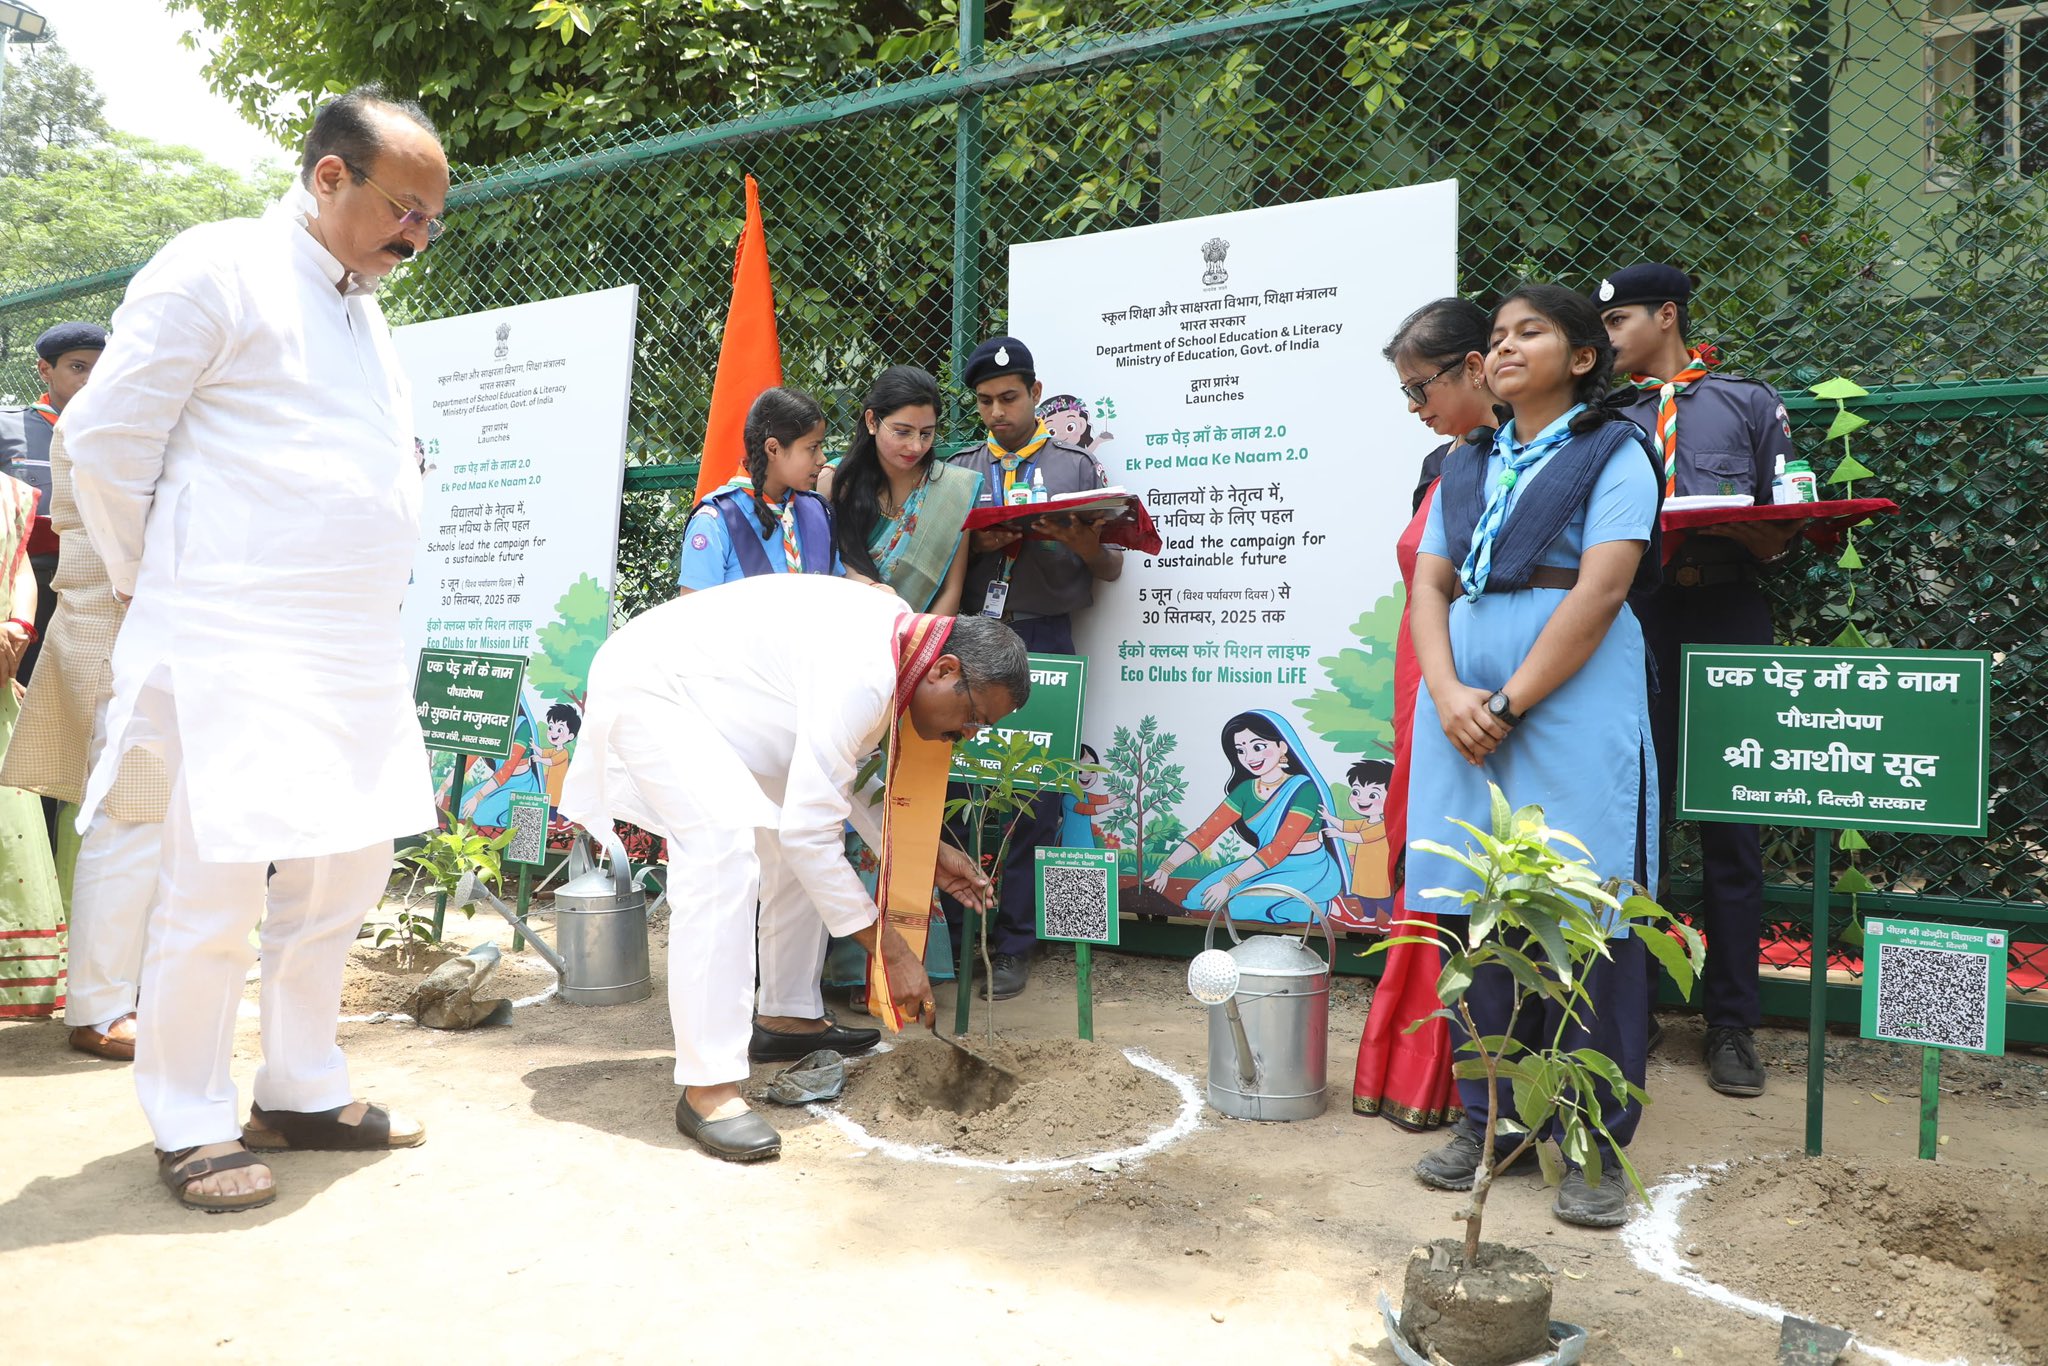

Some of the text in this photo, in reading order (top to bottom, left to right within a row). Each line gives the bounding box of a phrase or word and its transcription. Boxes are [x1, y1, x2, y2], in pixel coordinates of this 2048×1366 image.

[1101, 287, 1338, 325] स्कूल शिक्षा और साक्षरता विभाग, शिक्षा मंत्रालय
[1180, 315, 1246, 331] भारत सरकार
[1097, 323, 1343, 358] Department of School Education & Literacy
[1116, 338, 1319, 367] Ministry of Education, Govt. of India
[1191, 374, 1239, 392] द्वारा प्रारंभ
[433, 397, 469, 409] Department
[470, 395, 477, 403] of
[477, 392, 499, 402] School
[500, 389, 532, 399] Education
[540, 385, 566, 394] Literacy
[443, 396, 553, 416] Ministry of Education, Govt. of India
[1186, 391, 1244, 404] Launches
[478, 434, 510, 444] Launches
[1145, 433, 1169, 446] एक
[1193, 425, 1211, 442] माँ
[1213, 426, 1228, 441] के
[1231, 426, 1261, 440] नाम
[1265, 425, 1286, 438] 2.0
[454, 465, 467, 474] एक
[491, 459, 499, 470] के
[501, 460, 517, 469] नाम
[518, 459, 530, 468] 2.0
[1126, 448, 1308, 470] Ek Ped Maa Ke Naam 2.0
[442, 475, 541, 492] Ek Ped Maa Ke Naam 2.0
[1147, 482, 1283, 507] विद्यालयों के नेतृत्व में,
[451, 501, 525, 518] विद्यालयों के नेतृत्व में,
[1164, 509, 1205, 527] भविष्य
[1209, 508, 1224, 525] के
[1228, 506, 1256, 526] लिए
[1260, 509, 1294, 525] पहल
[459, 520, 482, 533] भविष्य
[484, 520, 492, 532] के
[494, 518, 510, 532] लिए
[512, 520, 530, 532] पहल
[427, 536, 546, 552] Schools lead the campaign for
[1167, 531, 1326, 551] lead the campaign for
[453, 552, 495, 564] sustainable
[499, 551, 524, 561] future
[1144, 551, 1286, 568] a sustainable future
[442, 596, 451, 605] 30
[485, 594, 504, 604] 2025
[507, 594, 520, 604] तक
[1139, 589, 1146, 601] 5
[1151, 589, 1173, 606] जून
[1278, 582, 1291, 599] से
[1143, 606, 1286, 626] 30 सितम्बर, 2025 तक
[427, 636, 529, 649] Eco Clubs for Mission LiFE
[1118, 640, 1311, 661] ईको क्लब्स फॉर मिशन लाइफ
[427, 661, 444, 672] एक
[463, 660, 478, 675] माँ
[478, 661, 490, 676] के
[491, 666, 514, 679] नाम
[1029, 669, 1068, 686] नाम
[1121, 666, 1306, 684] Eco Clubs for Mission LiFE
[1706, 667, 1756, 687] एक
[1813, 662, 1854, 689] माँ
[1857, 663, 1891, 690] के
[1897, 672, 1960, 692] नाम
[447, 684, 484, 699] पौधारोपण
[431, 705, 462, 724] सुकांत
[463, 711, 510, 730] मजुमदार
[1776, 706, 1884, 730] पौधारोपण
[1723, 738, 1940, 787] श्री आशीष सूद
[1732, 785, 1927, 811] शिक्षा मंत्री, दिल्ली सरकार
